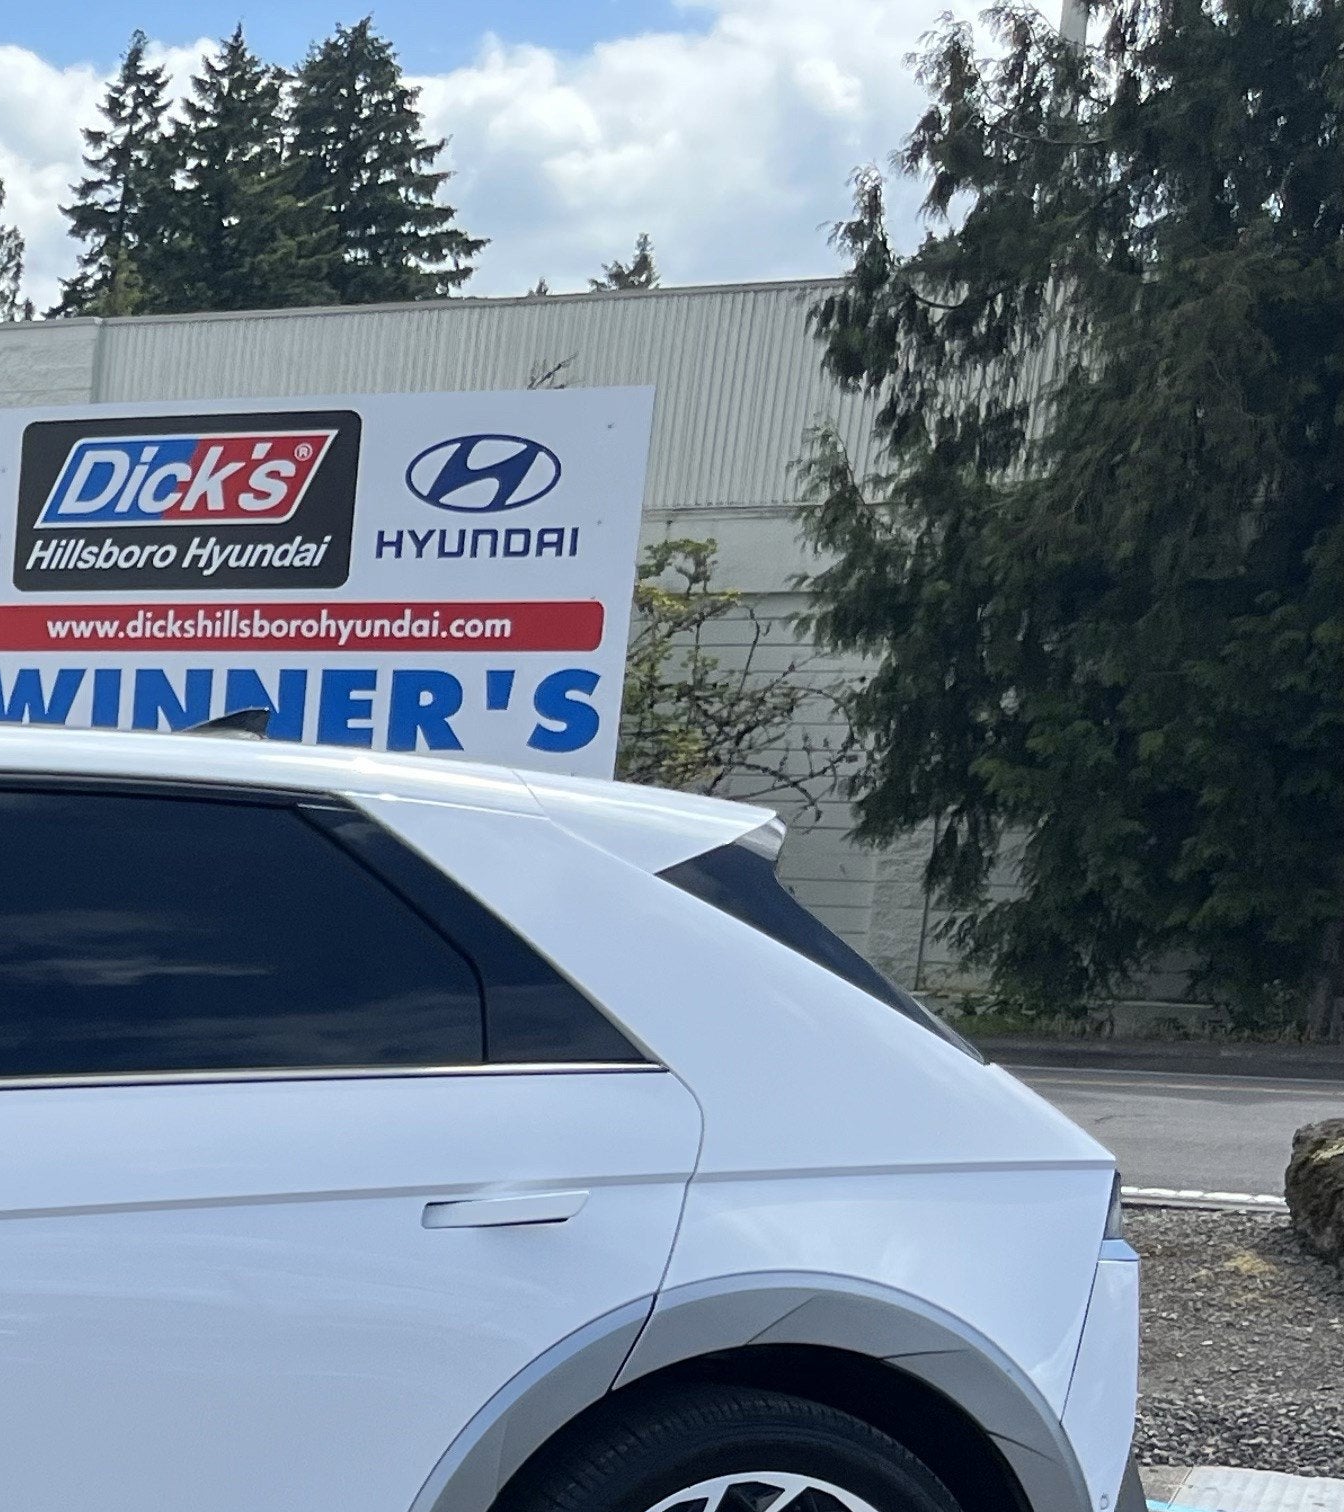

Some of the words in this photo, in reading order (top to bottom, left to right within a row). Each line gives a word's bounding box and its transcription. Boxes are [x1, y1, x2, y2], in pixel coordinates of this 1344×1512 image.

[57, 442, 297, 515] Dick's
[25, 538, 177, 570] Hillsboro
[182, 535, 332, 576] Hyundai
[375, 526, 580, 559] HYUNDAI
[47, 609, 511, 646] www.dickshillsborohyundai.com
